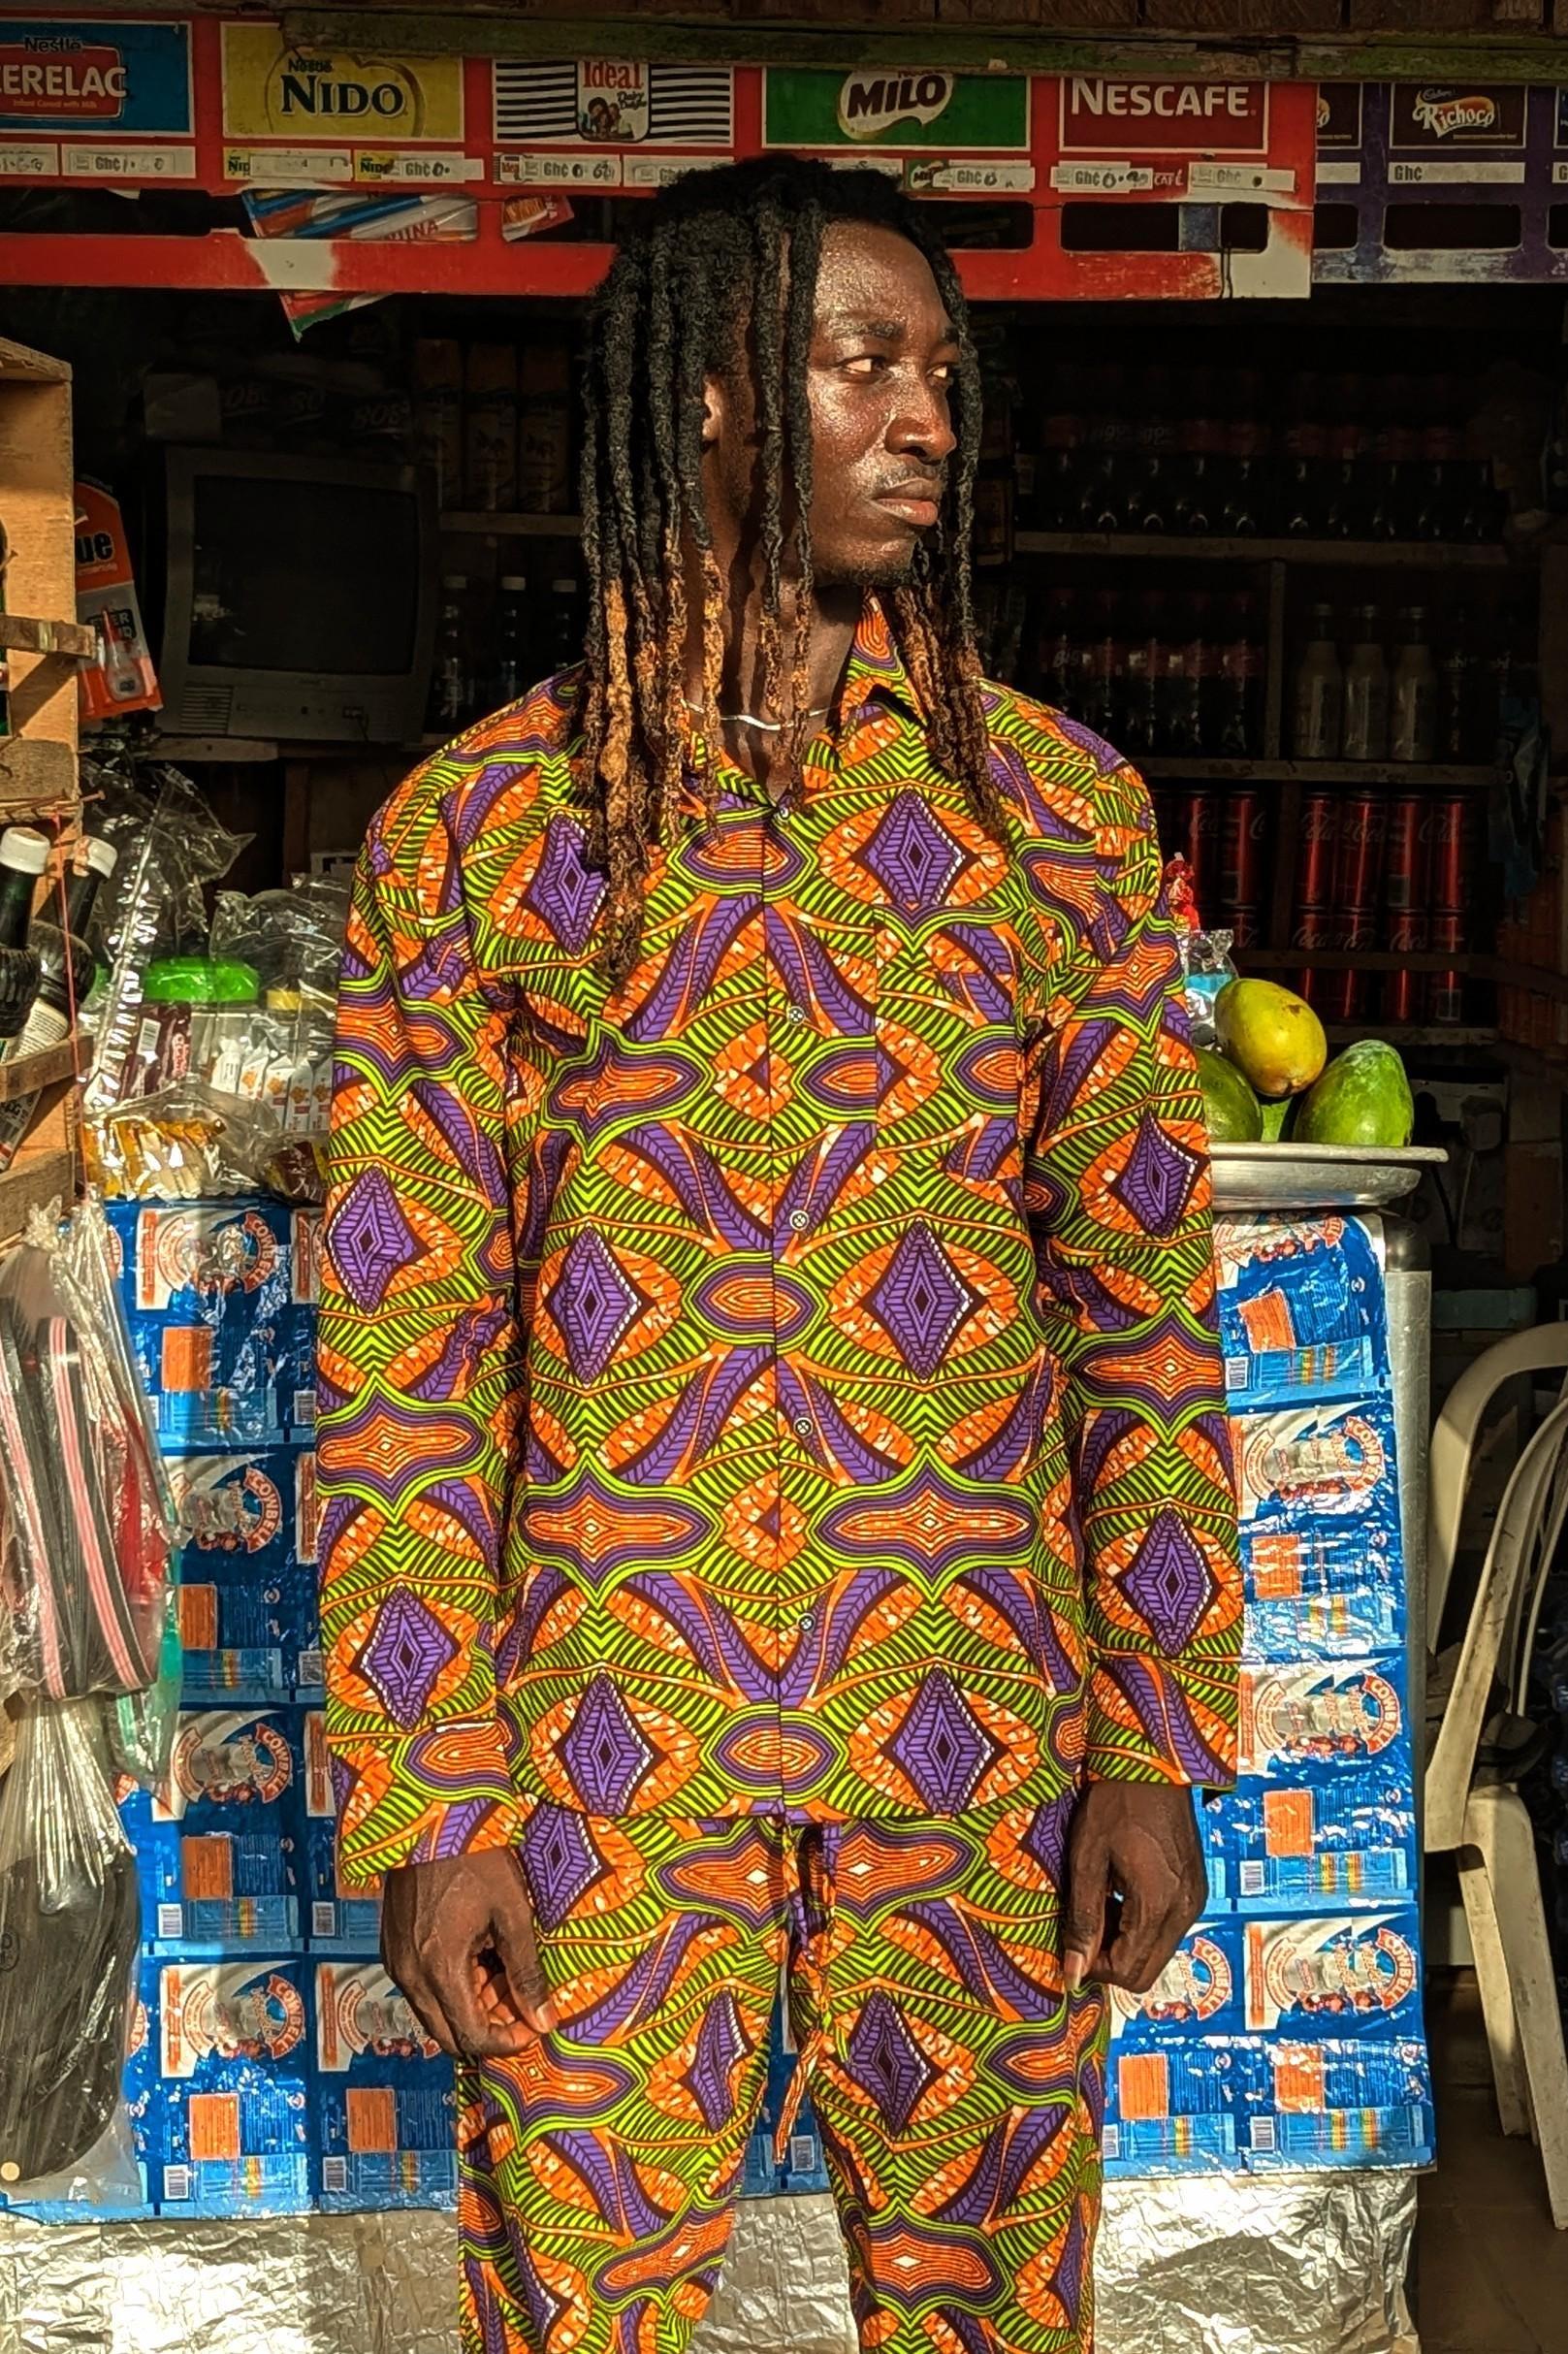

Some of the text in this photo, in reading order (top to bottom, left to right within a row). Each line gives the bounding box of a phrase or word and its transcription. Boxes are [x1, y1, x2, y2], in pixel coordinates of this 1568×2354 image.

[0, 64, 128, 98] ERELAC
[280, 75, 403, 114] NIDO
[583, 60, 645, 89] Ideal
[847, 74, 946, 118] MILO
[1412, 104, 1495, 138] Richoco
[249, 1218, 276, 1285] COWBELL
[252, 1473, 279, 1547] COWBELL
[1368, 1677, 1398, 1751] COWBELL
[262, 1730, 291, 1795] COWBELL
[1200, 1944, 1231, 2013] COWBELL
[1384, 1934, 1415, 2004] COWBELL
[275, 1981, 303, 2053] COWBELL
